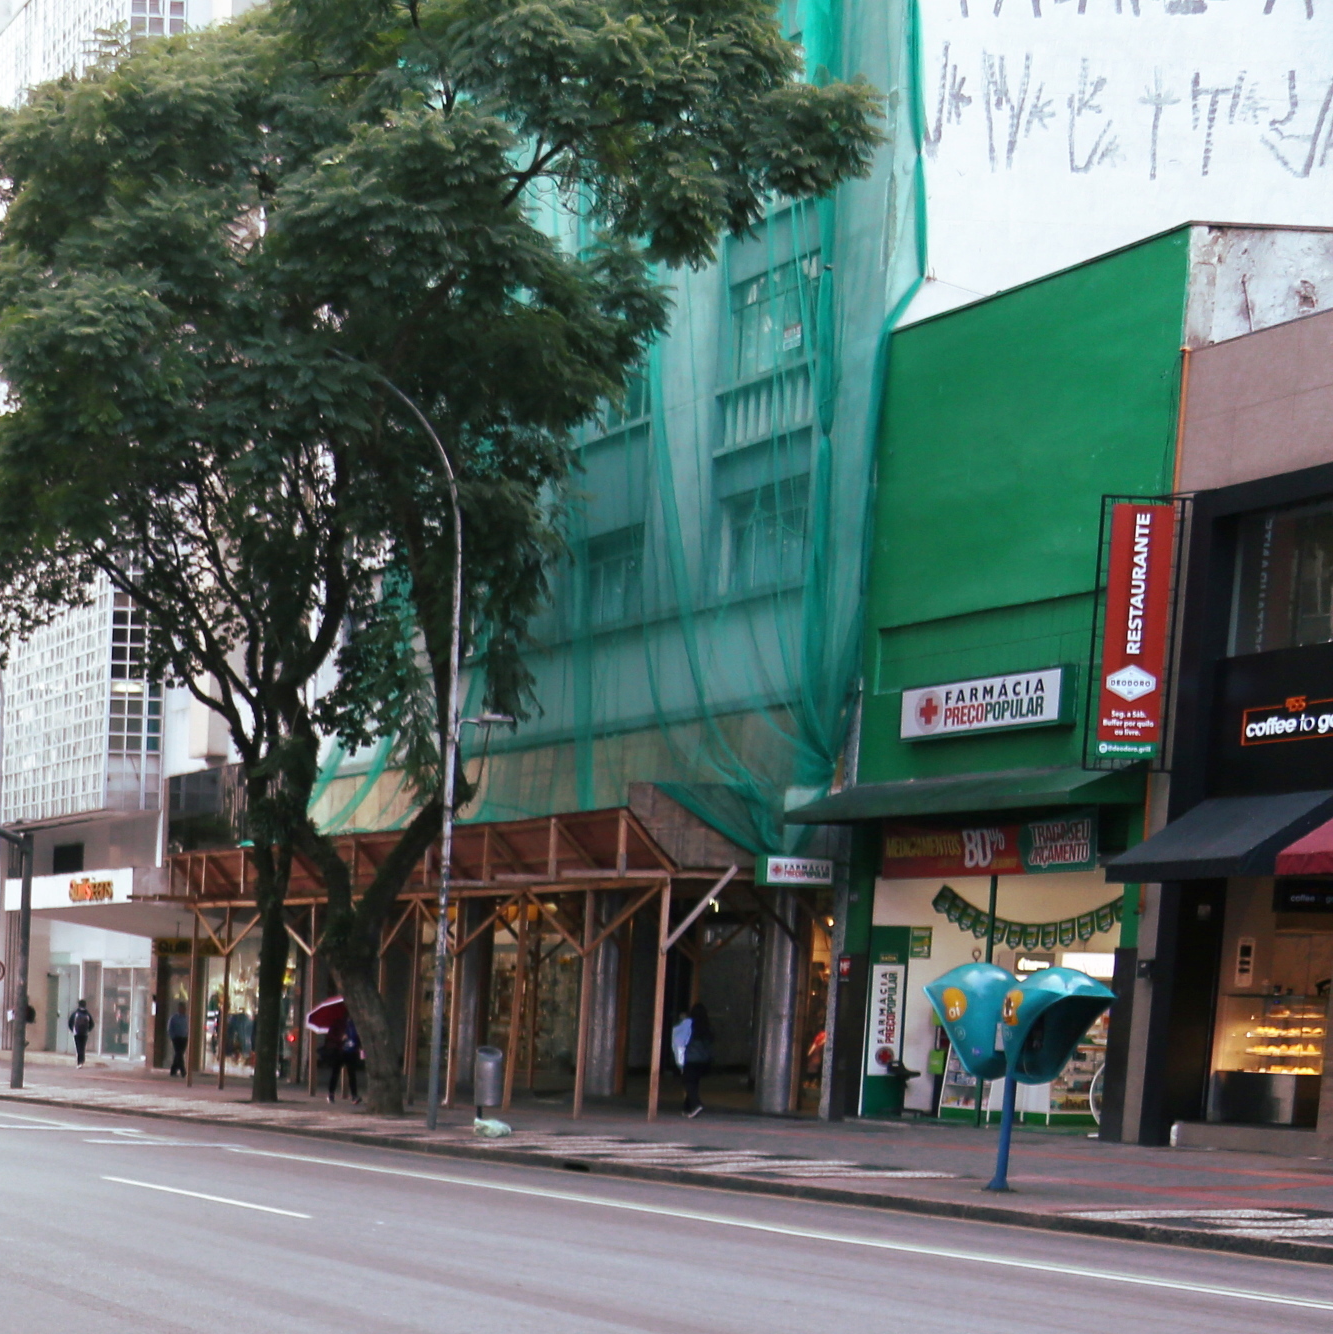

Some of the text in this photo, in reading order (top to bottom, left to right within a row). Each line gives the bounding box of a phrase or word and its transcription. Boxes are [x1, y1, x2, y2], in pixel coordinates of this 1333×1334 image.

[1126, 513, 1151, 654] RESTAURANTE
[945, 678, 1045, 706] FARMÁCIA
[1110, 680, 1151, 688] DEODORO
[944, 695, 1044, 728] PREÇOPOPULAR
[1246, 715, 1297, 738] coffee
[1299, 713, 1315, 732] to
